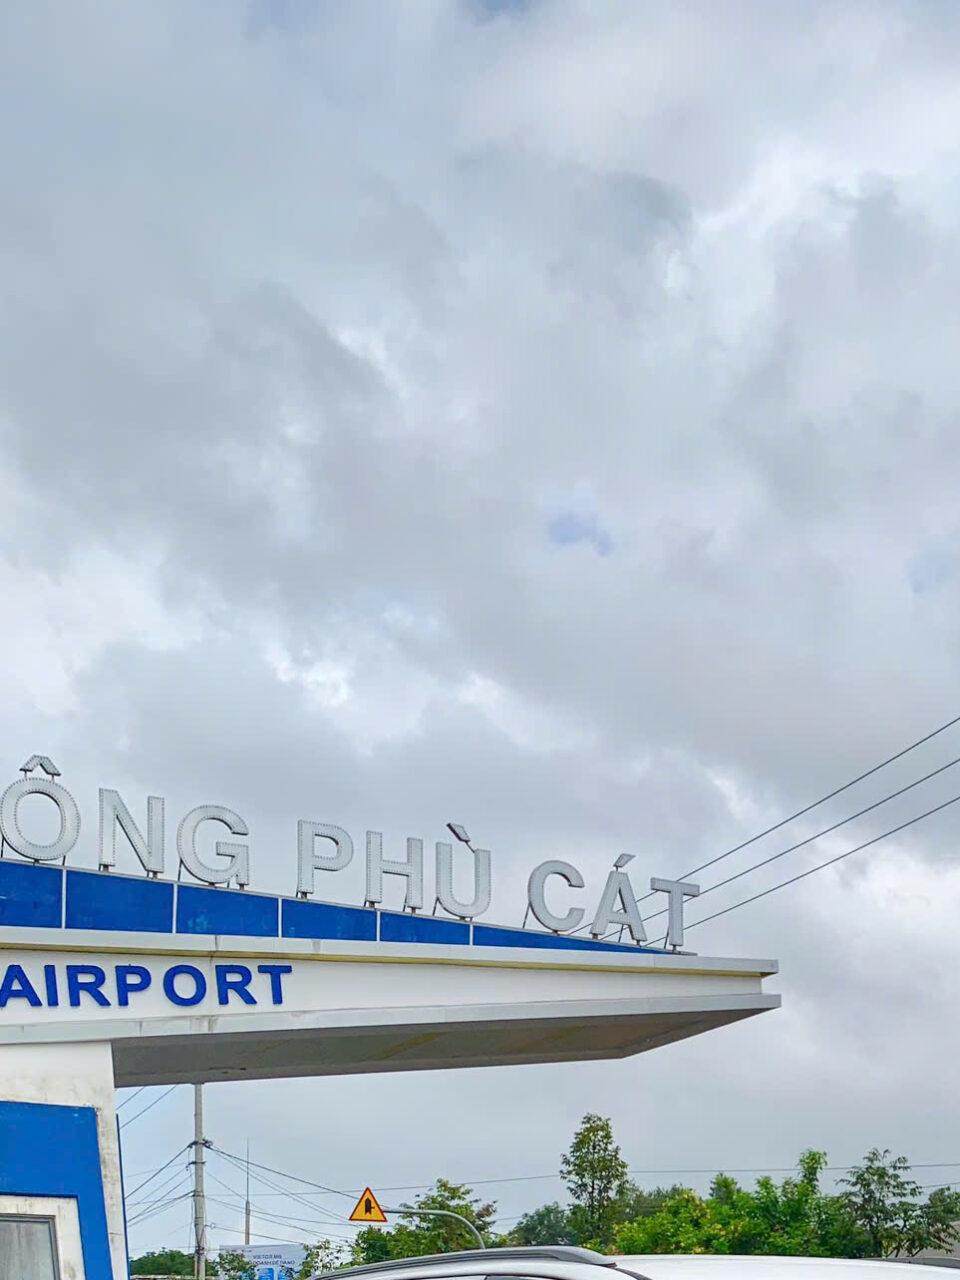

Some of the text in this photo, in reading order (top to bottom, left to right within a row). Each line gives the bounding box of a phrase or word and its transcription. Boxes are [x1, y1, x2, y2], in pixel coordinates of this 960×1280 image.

[297, 820, 492, 919] PHÙ
[527, 853, 700, 947] CÁT
[0, 964, 293, 1007] AIRPORT
